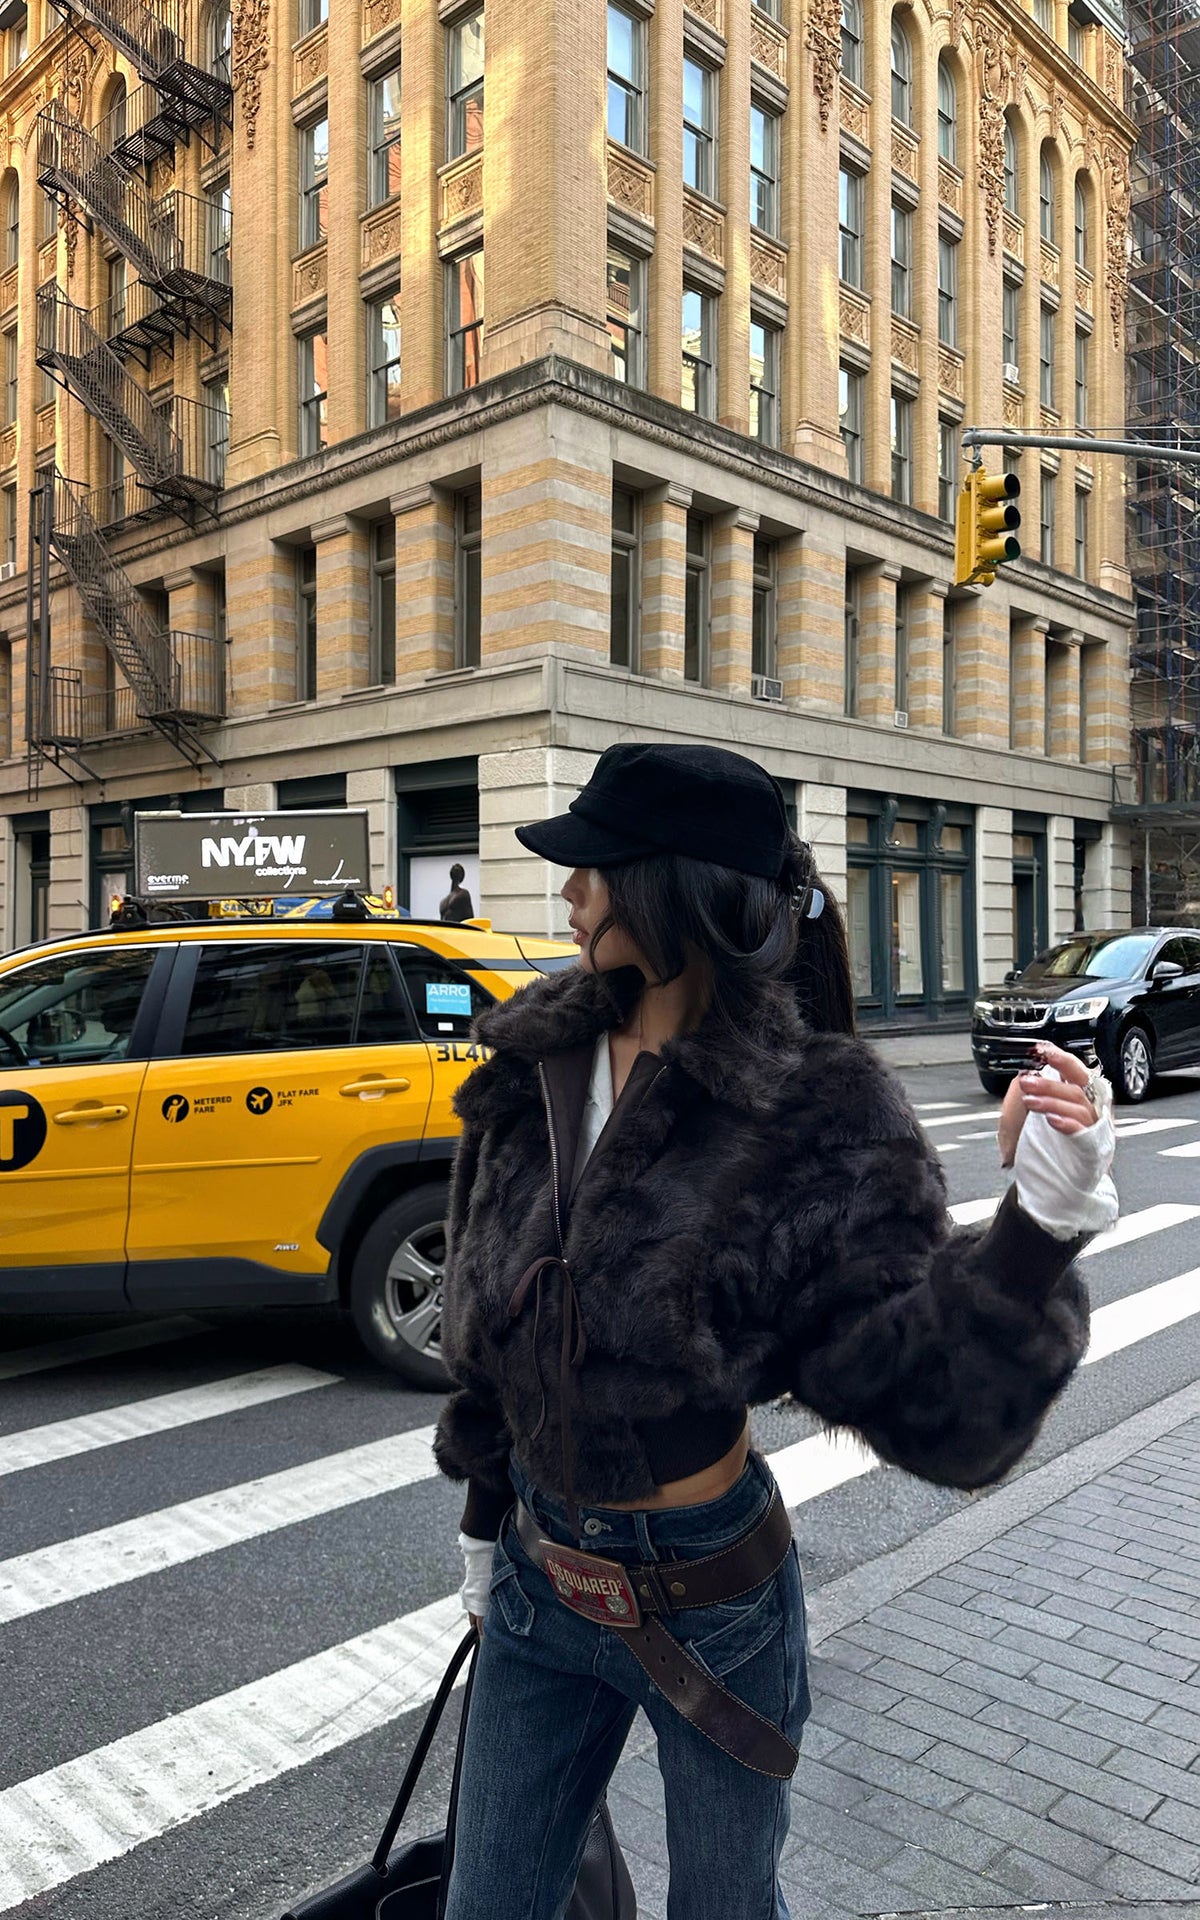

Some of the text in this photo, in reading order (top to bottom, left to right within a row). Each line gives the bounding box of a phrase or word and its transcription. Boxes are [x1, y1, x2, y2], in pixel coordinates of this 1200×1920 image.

[255, 866, 307, 876] collections
[429, 984, 469, 997] ARRO
[277, 1088, 319, 1099] FLAT FARE
[194, 1096, 232, 1105] METERED
[277, 1099, 293, 1107] JFK
[194, 1106, 215, 1114] FARE
[0, 1105, 29, 1160] T
